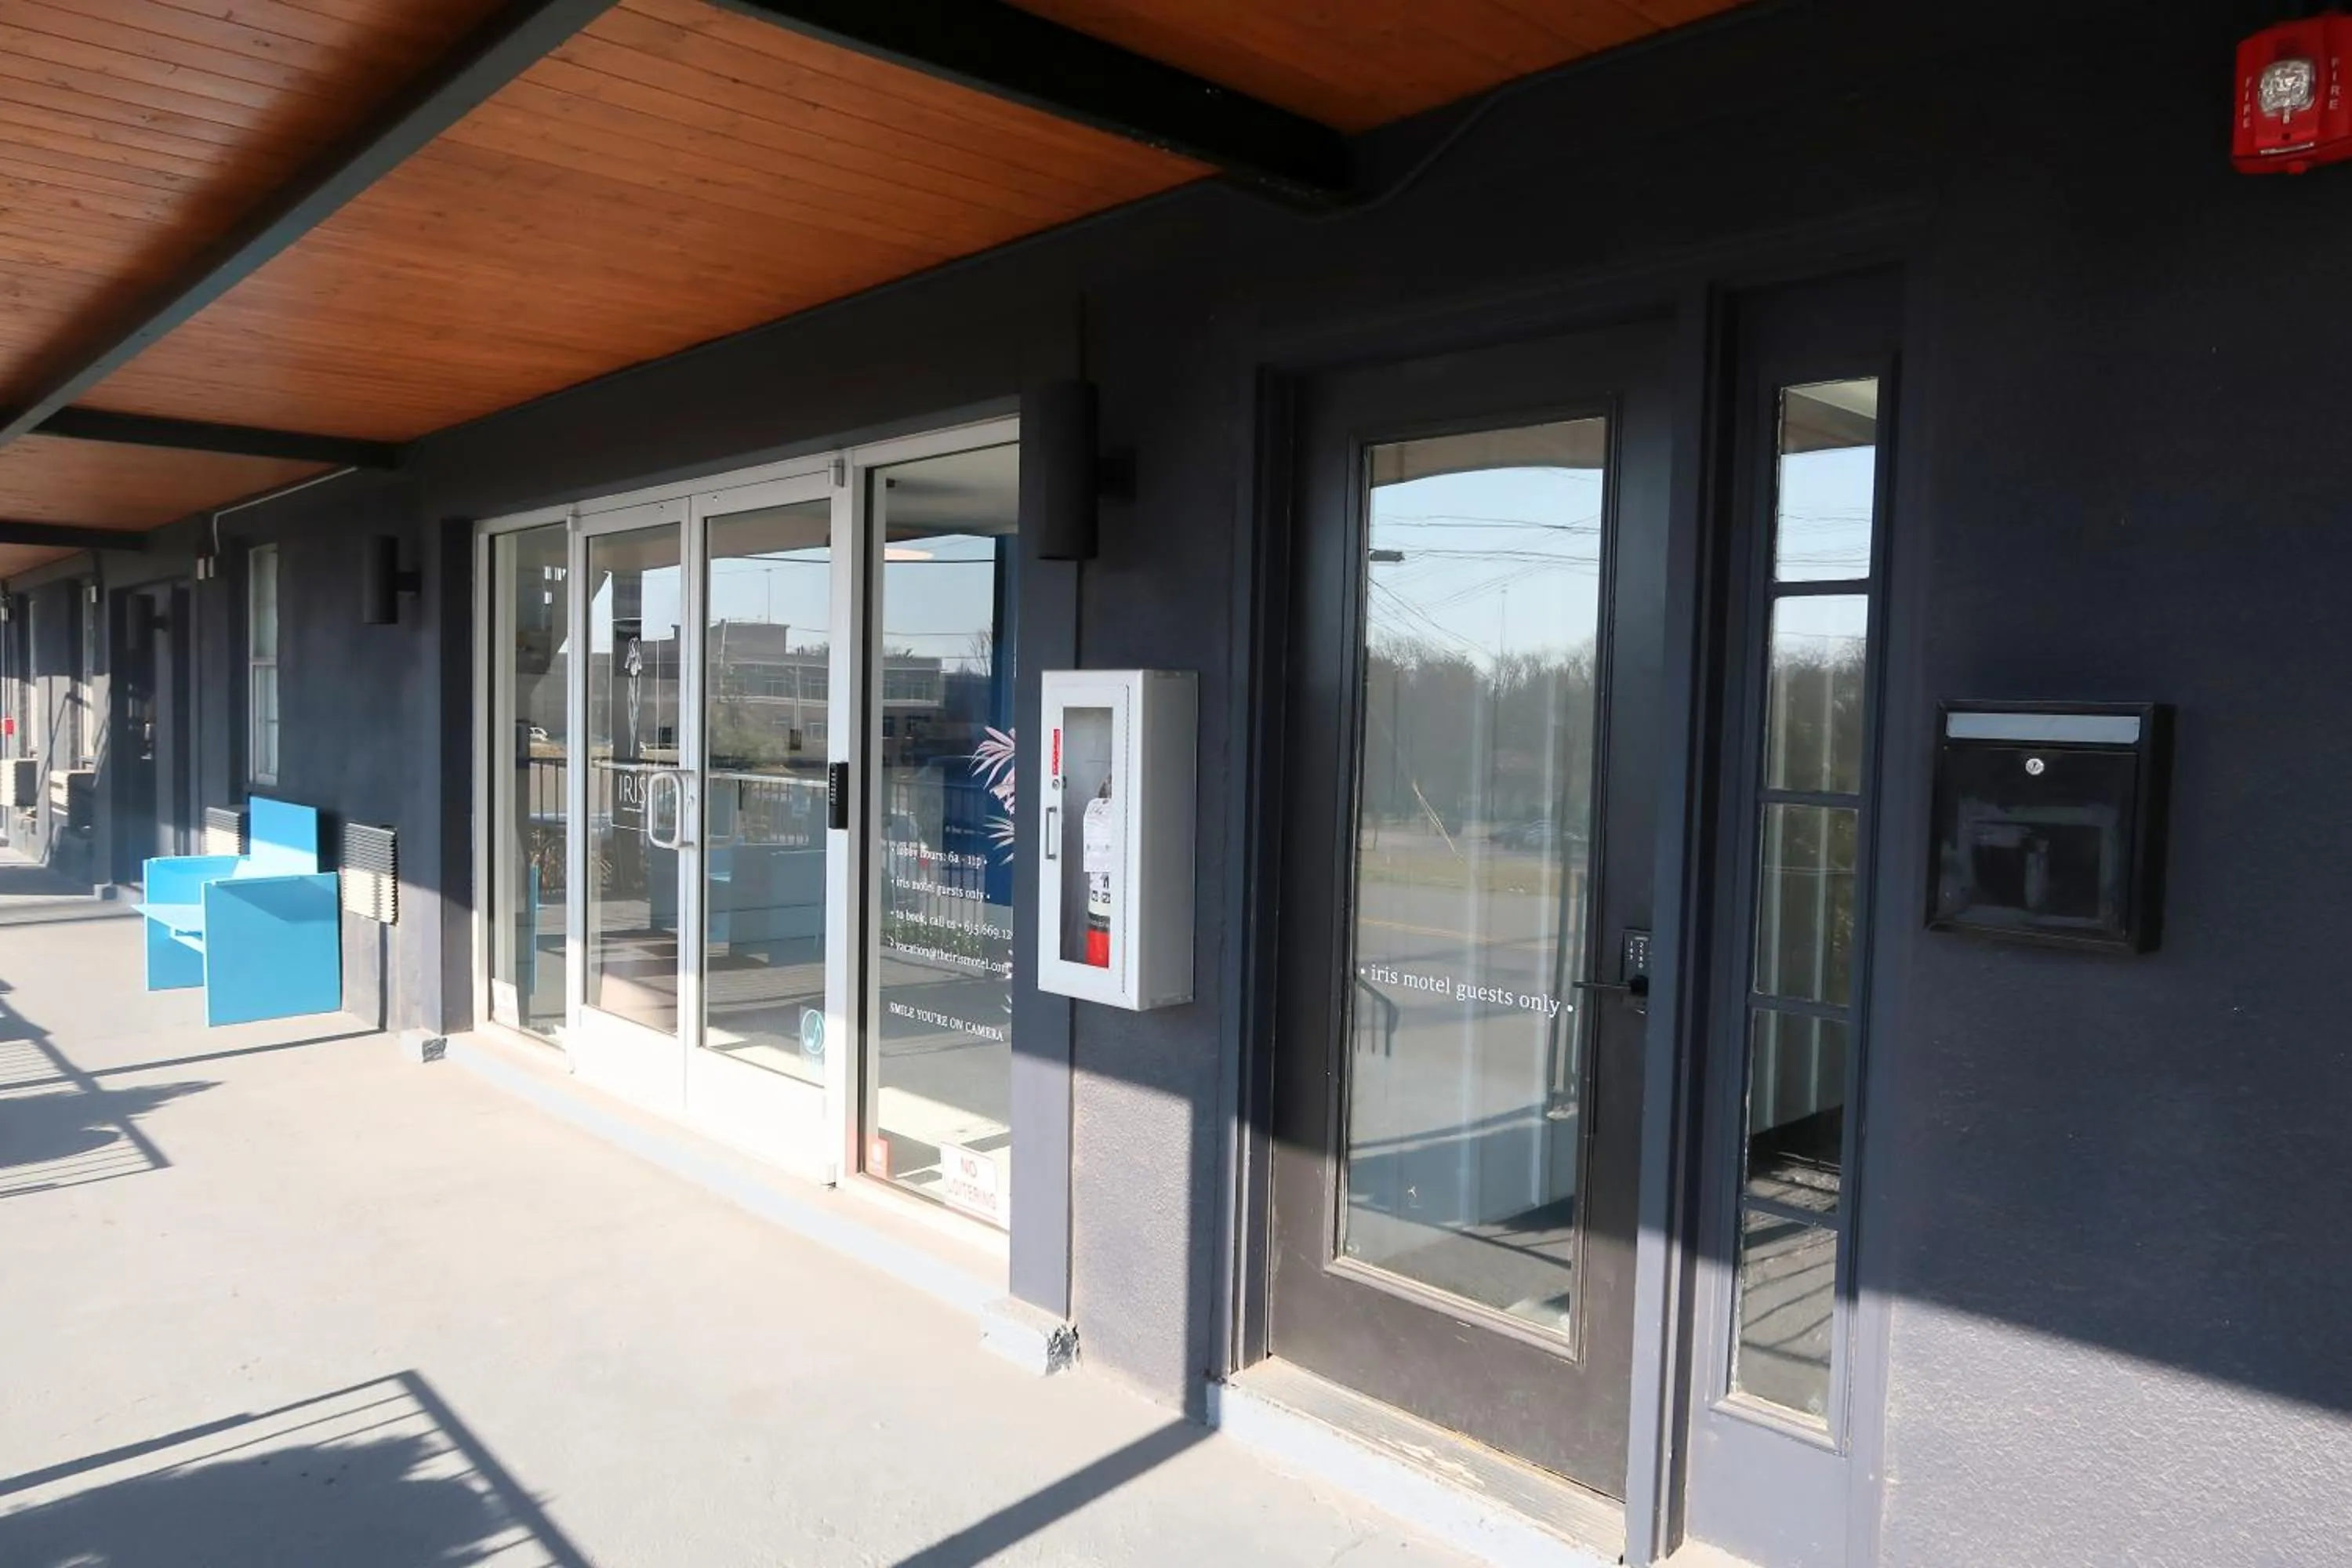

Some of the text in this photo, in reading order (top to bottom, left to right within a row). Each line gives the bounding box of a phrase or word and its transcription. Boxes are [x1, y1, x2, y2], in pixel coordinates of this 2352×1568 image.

[2328, 57, 2340, 110] FIRE
[2243, 76, 2252, 129] FIRE
[619, 774, 646, 804] IRIS
[896, 875, 909, 888] iris
[1371, 964, 1561, 1018] iris motel guests only
[890, 1001, 915, 1018] SMILE
[949, 1017, 963, 1029] ON
[965, 1022, 1004, 1042] CAMERA
[960, 1156, 978, 1178] NO
[947, 1176, 996, 1210] LOITERING
